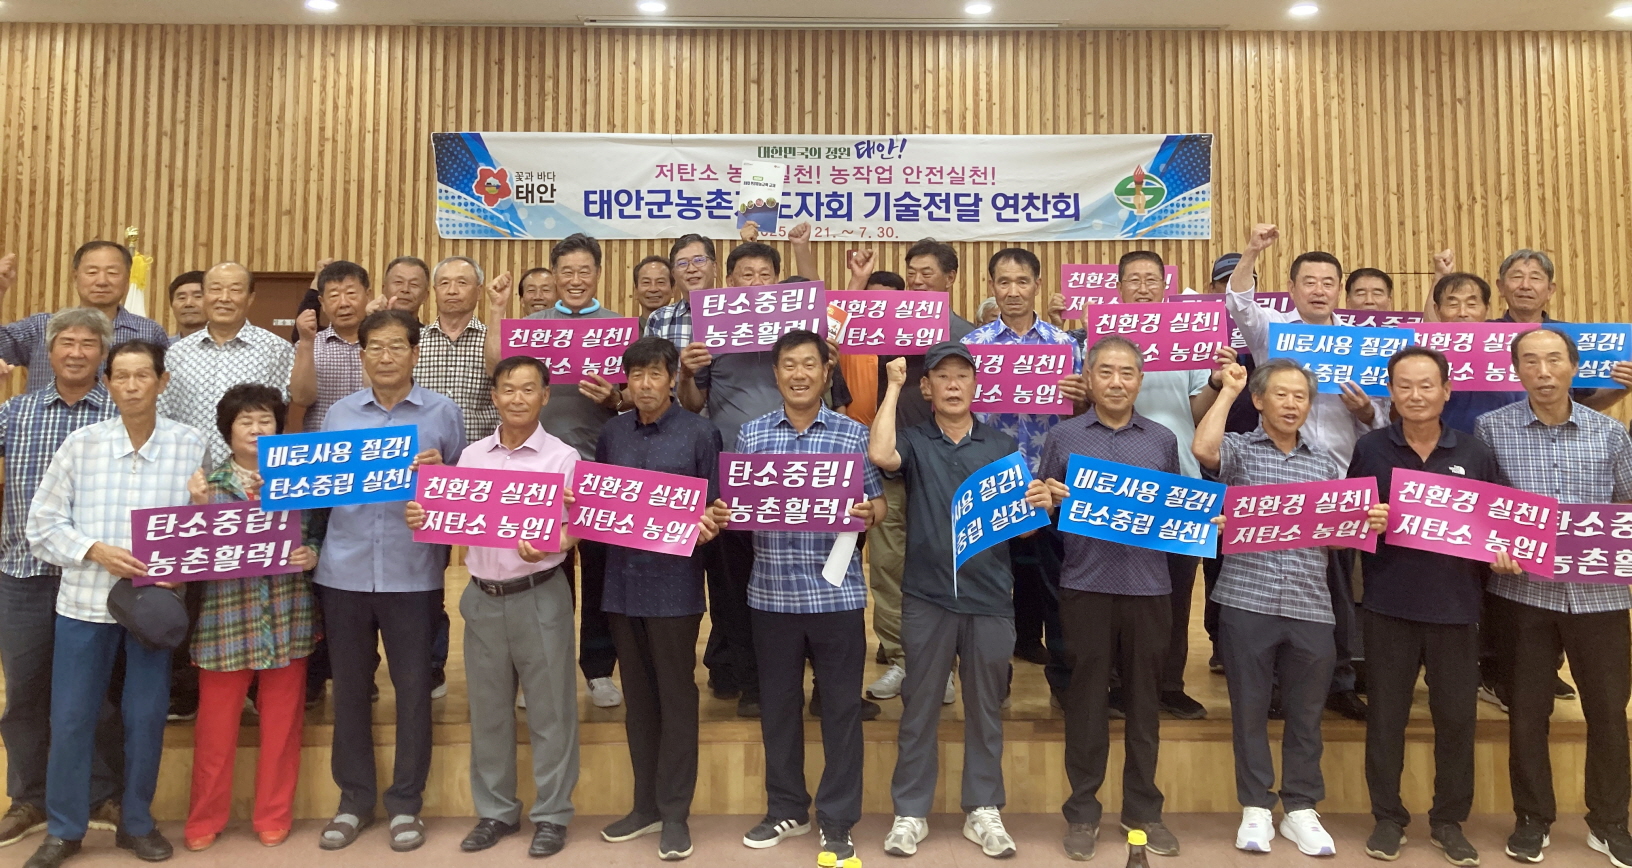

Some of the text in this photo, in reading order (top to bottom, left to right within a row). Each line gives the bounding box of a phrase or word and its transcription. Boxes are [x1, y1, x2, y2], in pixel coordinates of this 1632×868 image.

[757, 138, 907, 160] 대한민국의 정원 태안!
[515, 171, 556, 182] 꽃과 바다
[655, 163, 719, 182] 저탄소
[830, 165, 893, 185] 농작업
[902, 166, 996, 186] 안전실천!
[515, 183, 557, 204] 태안
[583, 189, 1081, 223] 태안군농촌자회 기술전달 연찬회
[814, 227, 836, 238] 21.
[877, 227, 899, 239] 30.
[1067, 272, 1120, 289] 친환경
[703, 287, 817, 317] 탄소중립!
[894, 300, 943, 319] 실천!
[1095, 311, 1220, 334] 친환경 실천!
[508, 327, 632, 348] 친환경 실천!
[842, 328, 886, 346] 탄소
[895, 328, 944, 347] 농업!
[1169, 341, 1223, 362] 농업!
[1275, 333, 1353, 355] 비료사용
[1577, 333, 1626, 352] 절감!
[581, 356, 626, 376] 농업
[1013, 354, 1066, 375] 실천!
[1578, 361, 1617, 379] 실천
[1013, 384, 1064, 405] 농업!
[266, 436, 411, 467] 비료사용 절감!
[269, 469, 412, 500] 탄소중립 실천!
[728, 460, 855, 488] 탄소중립!
[979, 464, 1024, 502] 절감!
[424, 476, 557, 507] 친환경 실천!
[579, 473, 700, 512] 친환경 실천!
[1073, 468, 1217, 513] 비료사용 절감!
[1233, 489, 1371, 518] 친환경 실천!
[1398, 480, 1550, 529] 친환경 실천!
[146, 508, 288, 541] 탄소중립!
[573, 506, 696, 544] 저탄소 농업!
[730, 497, 855, 525] 농촌활력!
[1069, 500, 1210, 545] 탄소중립 실천!
[421, 510, 554, 541] 저탄소 농업!
[956, 517, 984, 555] 중립
[1230, 520, 1370, 545] 저탄소 농업!
[1393, 513, 1548, 563] 저탄소 농업!
[147, 540, 292, 577] 농촌활력!
